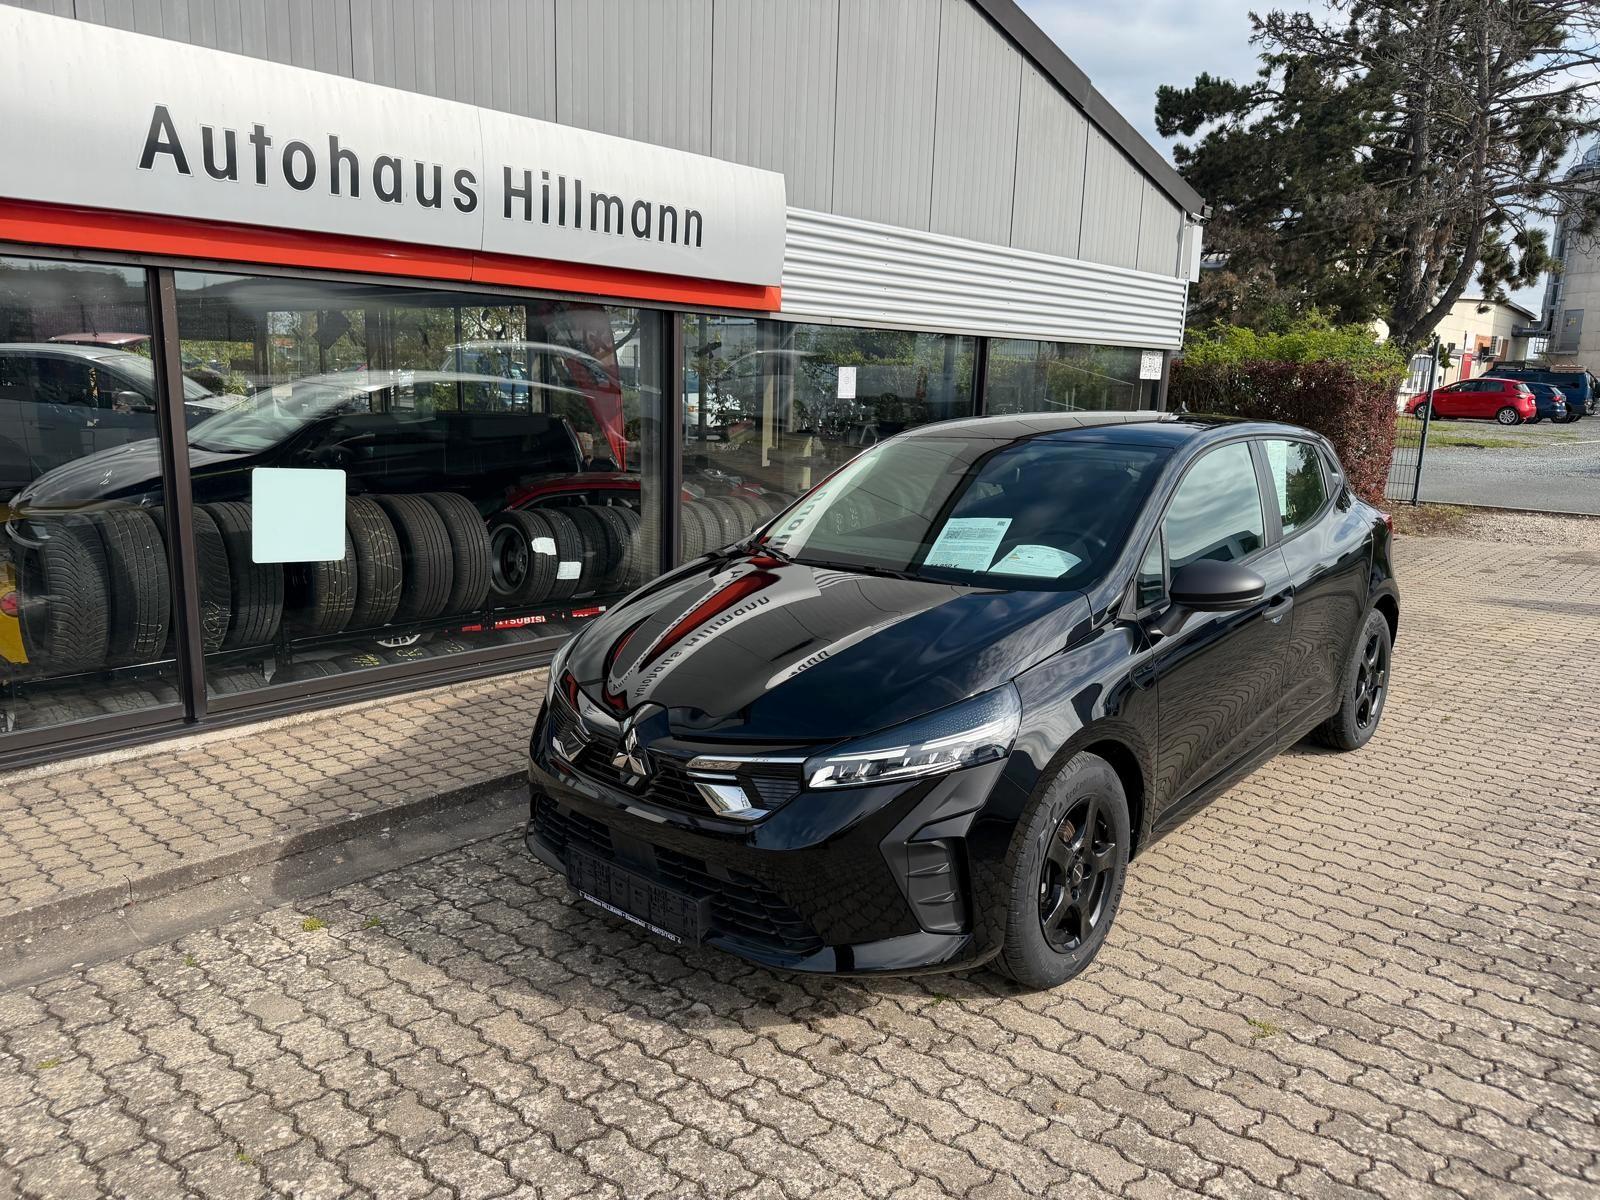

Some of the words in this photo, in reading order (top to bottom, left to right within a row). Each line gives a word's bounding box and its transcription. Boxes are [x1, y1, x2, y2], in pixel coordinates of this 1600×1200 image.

[138, 103, 479, 214] Autohaus
[502, 165, 703, 248] Hillmann
[602, 902, 623, 917] HILLMANN
